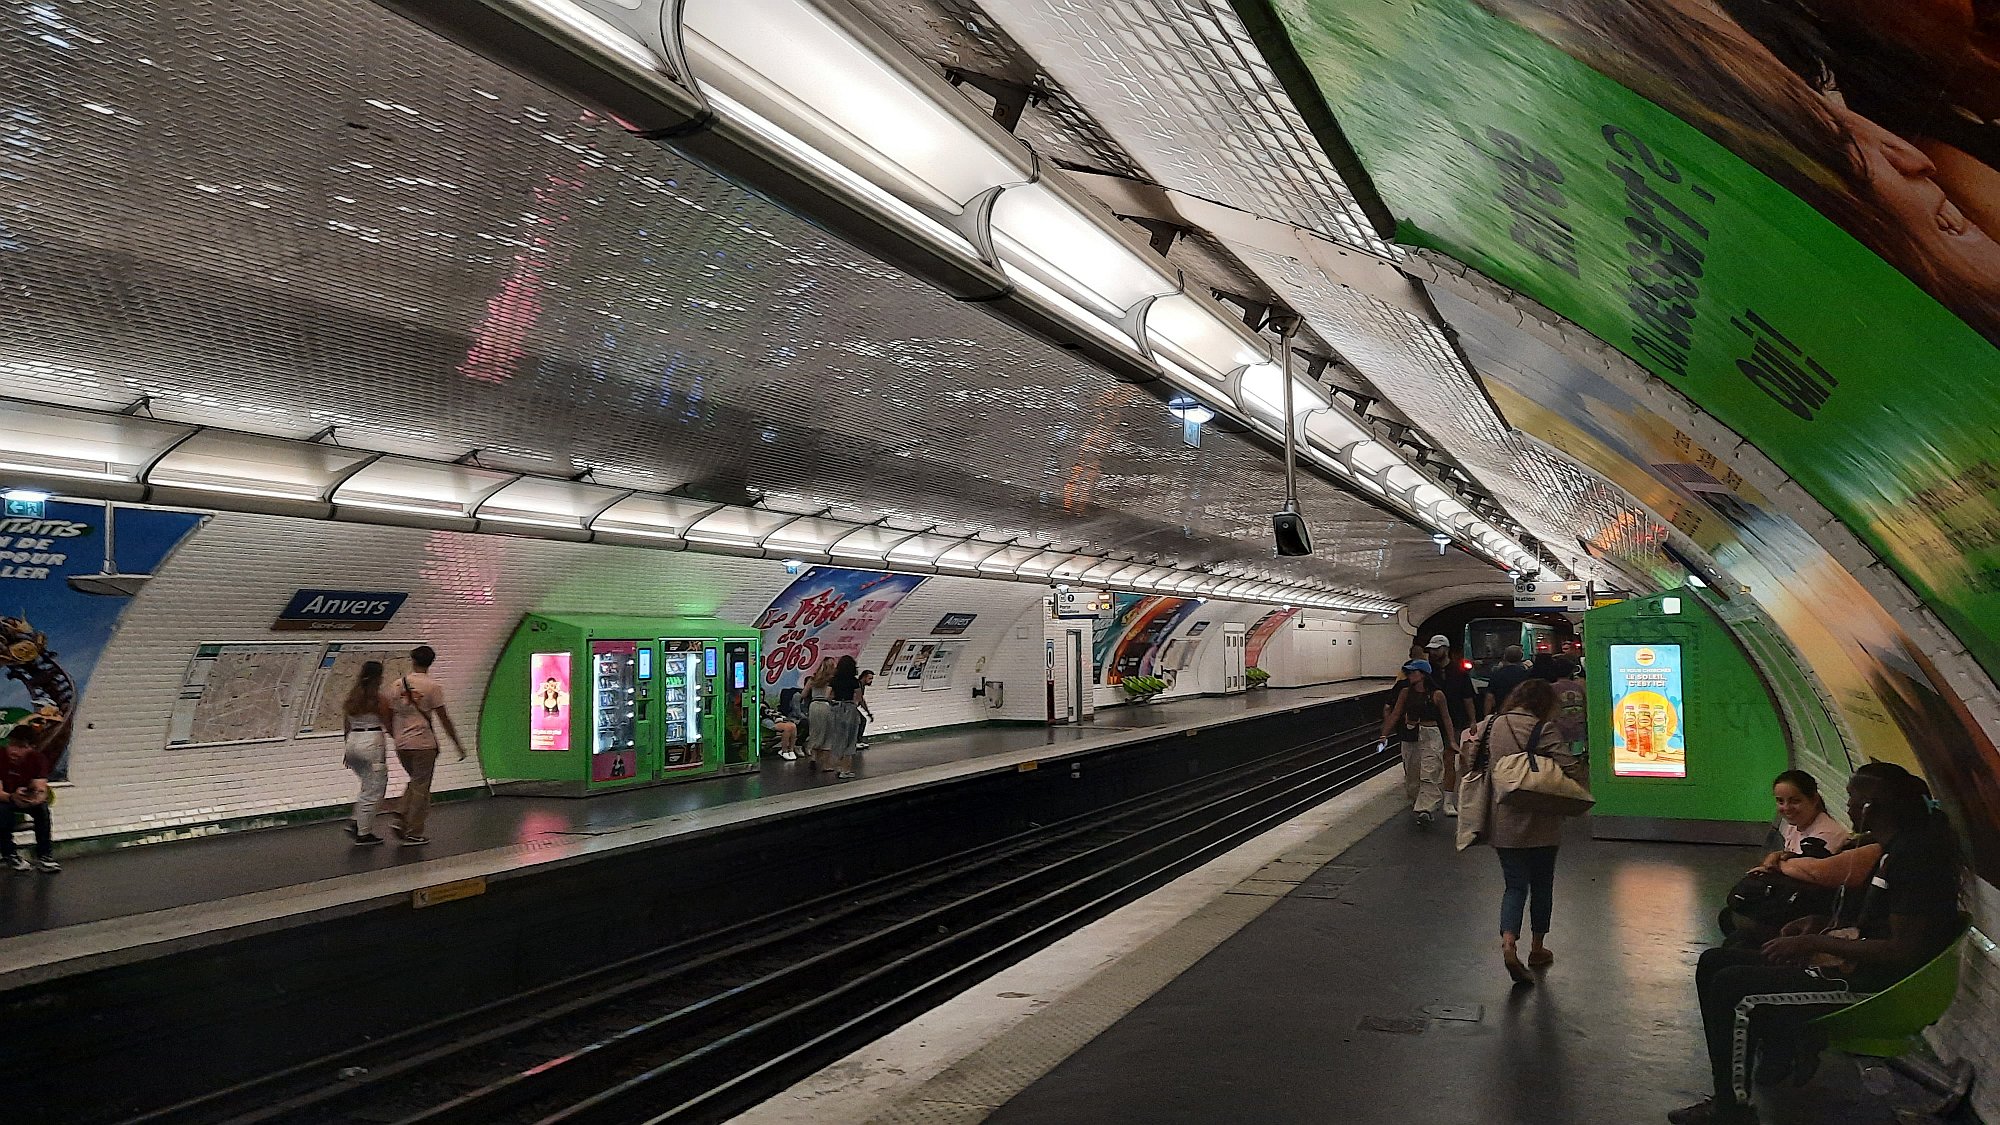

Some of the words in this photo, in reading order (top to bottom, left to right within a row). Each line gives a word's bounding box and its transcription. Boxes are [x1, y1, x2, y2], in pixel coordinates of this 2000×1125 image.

[1606, 159, 1710, 351] dessert
[1630, 326, 1690, 378] ou
[15, 537, 55, 550] DE
[301, 595, 390, 615] Anvers
